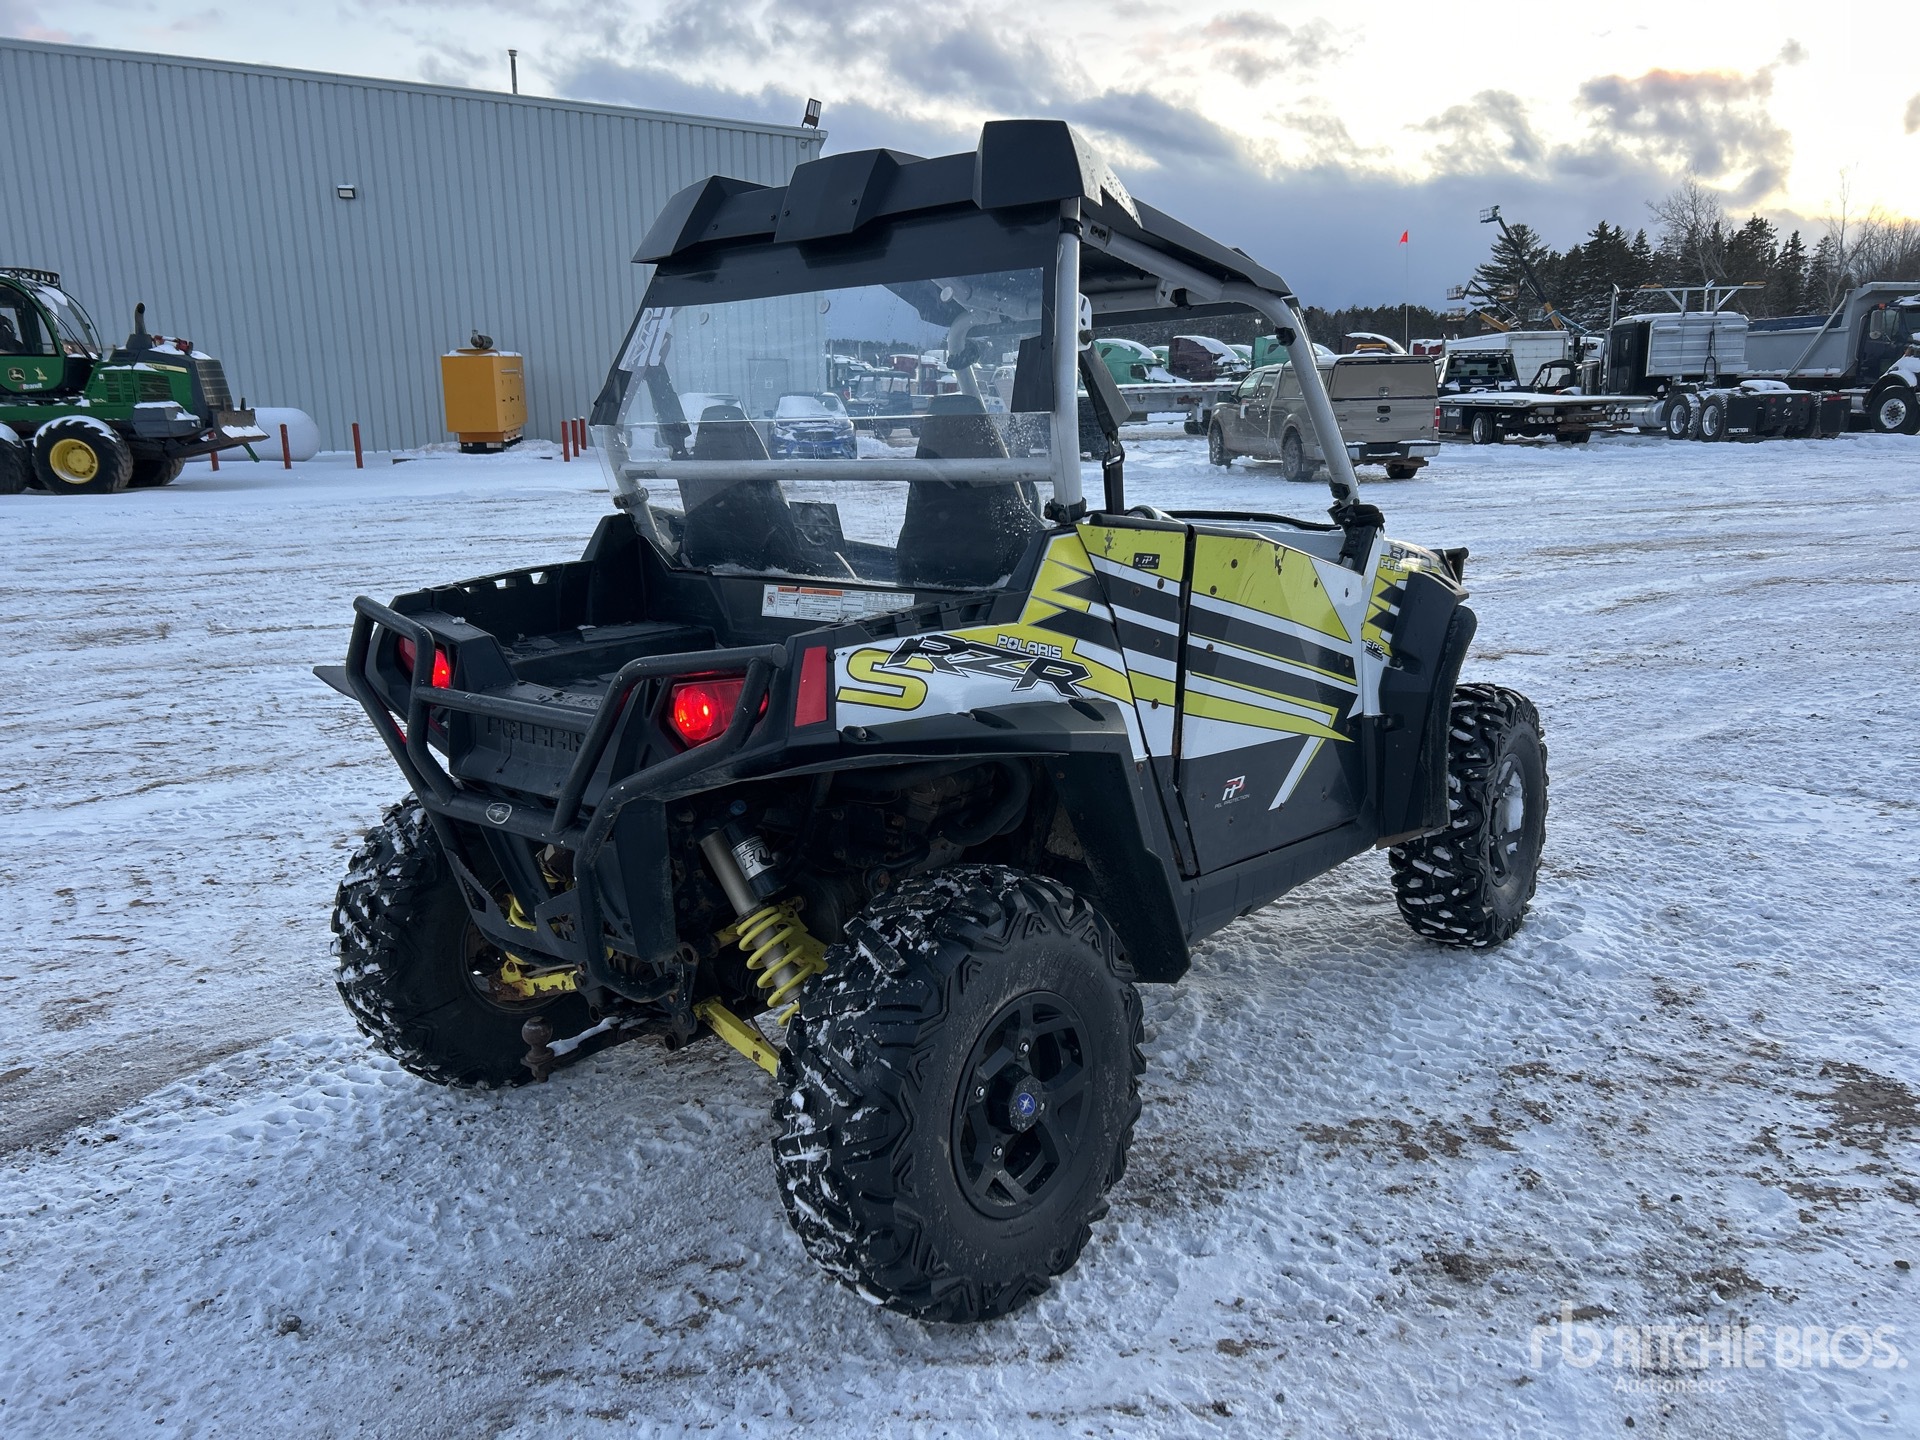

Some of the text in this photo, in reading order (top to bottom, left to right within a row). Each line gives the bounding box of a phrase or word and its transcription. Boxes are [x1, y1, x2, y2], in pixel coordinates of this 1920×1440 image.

[995, 634, 1062, 659] POLARIS
[1366, 639, 1385, 654] EPS
[836, 632, 1093, 712] S RZR
[741, 846, 770, 870] FO
